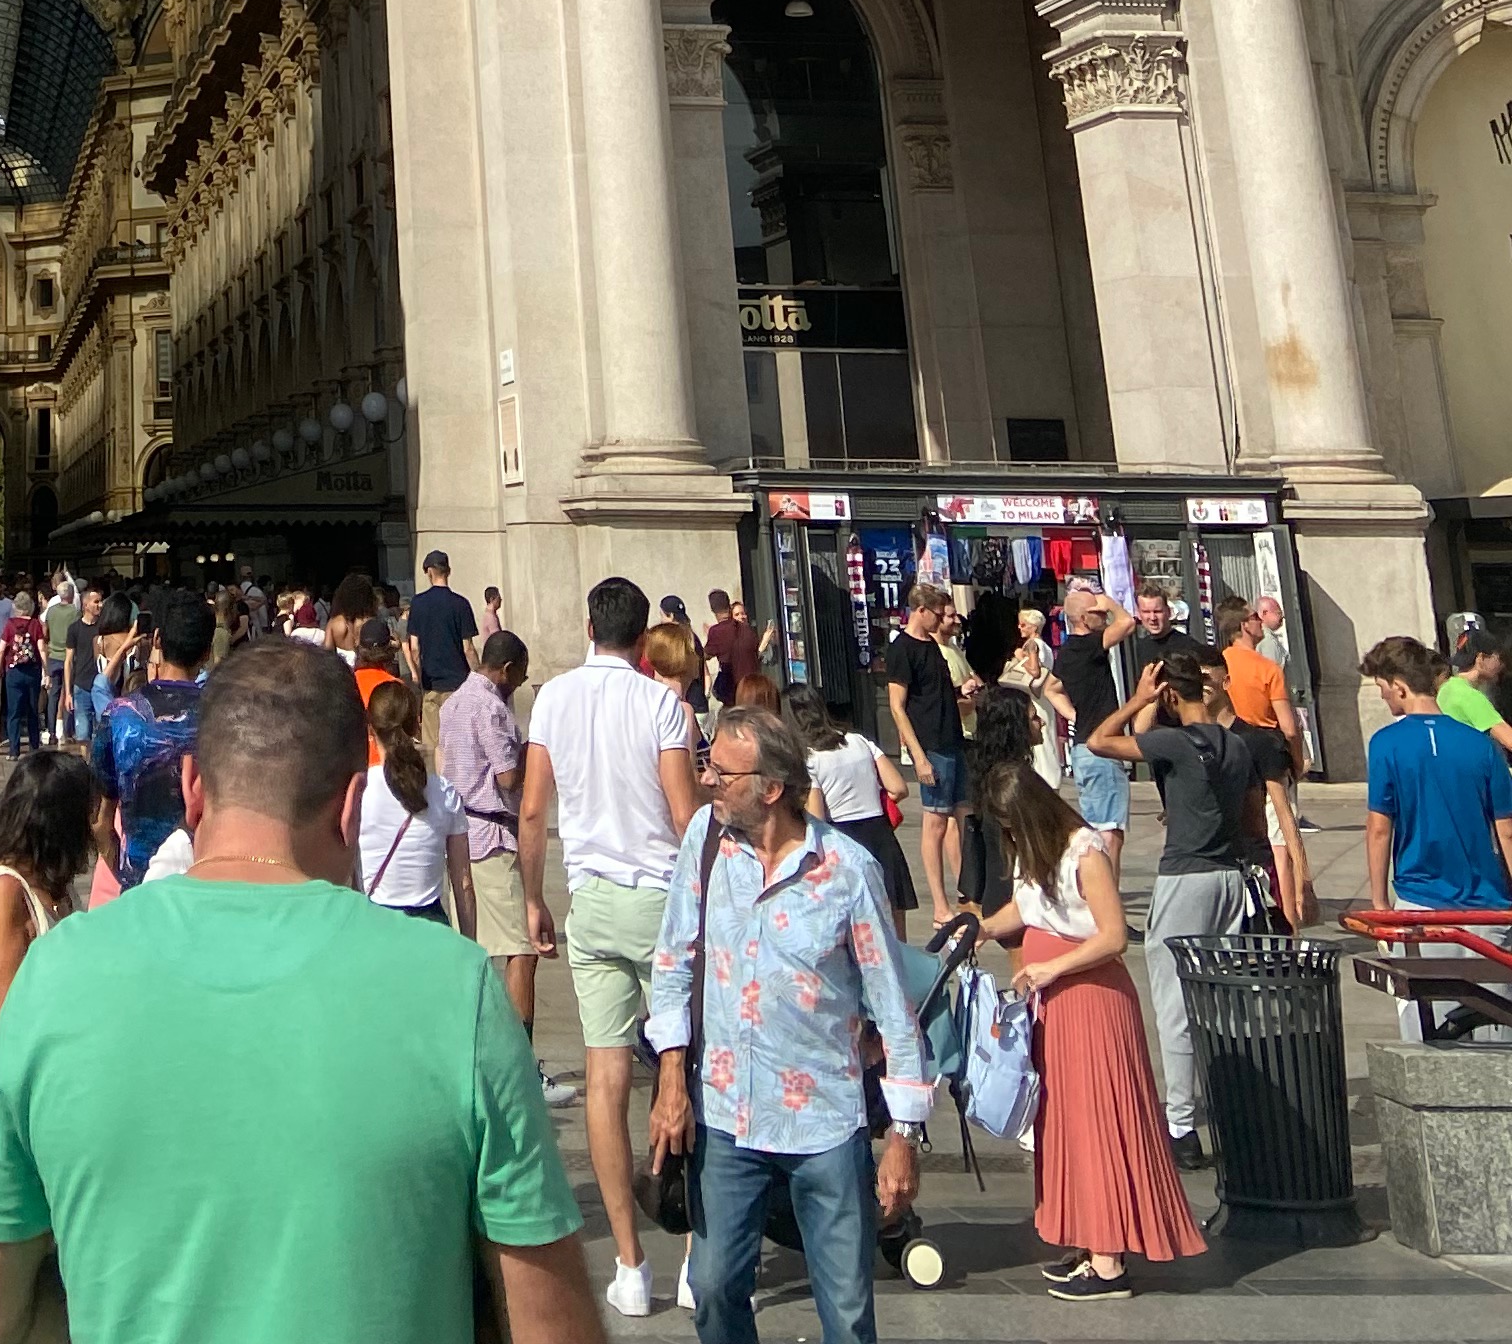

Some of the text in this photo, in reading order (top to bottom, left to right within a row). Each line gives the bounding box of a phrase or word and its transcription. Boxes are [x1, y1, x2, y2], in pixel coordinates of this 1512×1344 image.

[316, 470, 373, 492] Motta
[1001, 496, 1056, 508] WELCOME
[1001, 511, 1015, 520] TO
[1018, 511, 1060, 521] MILANO
[880, 582, 899, 609] 11
[855, 609, 869, 647] INTER
